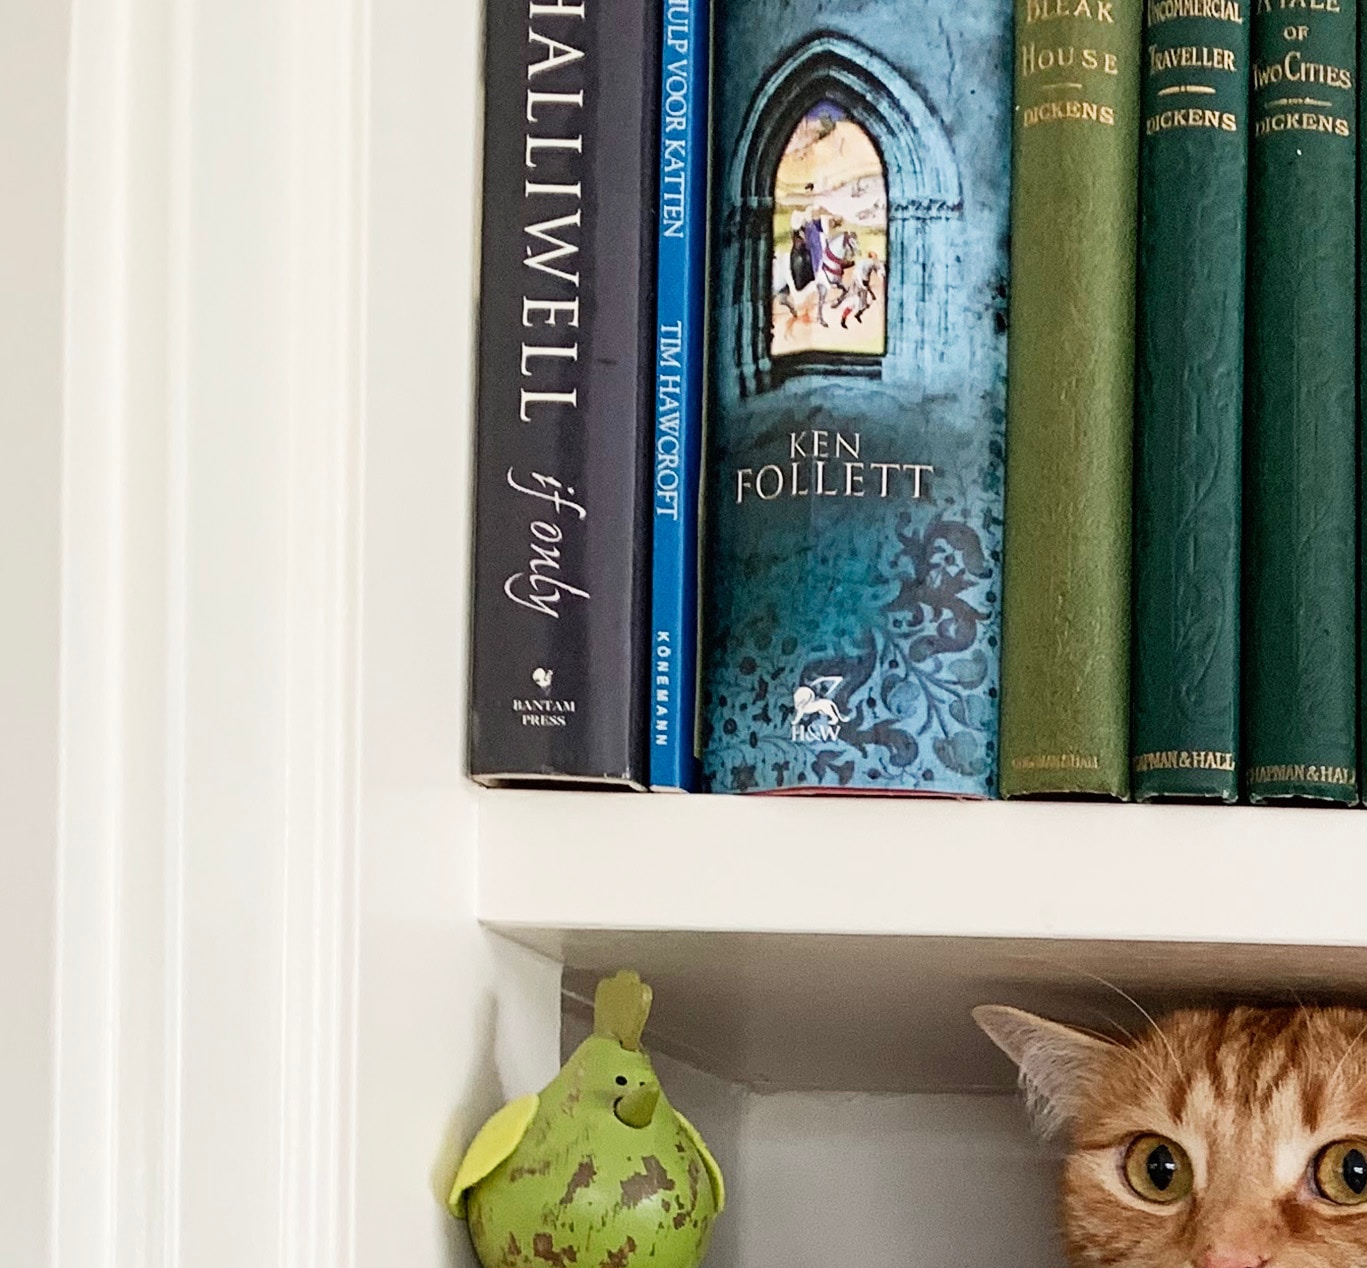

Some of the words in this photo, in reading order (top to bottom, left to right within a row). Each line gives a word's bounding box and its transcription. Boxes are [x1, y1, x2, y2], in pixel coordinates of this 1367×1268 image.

[663, 58, 688, 132] VOOR
[660, 139, 687, 240] KATTEN
[658, 321, 684, 369] TIM
[654, 375, 682, 521] HAWCROFT
[789, 430, 862, 460] KEN
[507, 468, 586, 523] if
[735, 463, 935, 505] FOLLETT
[505, 524, 590, 619] only
[512, 698, 576, 715] BANTAM
[521, 713, 567, 727] PRESS
[790, 723, 841, 741] H&W
